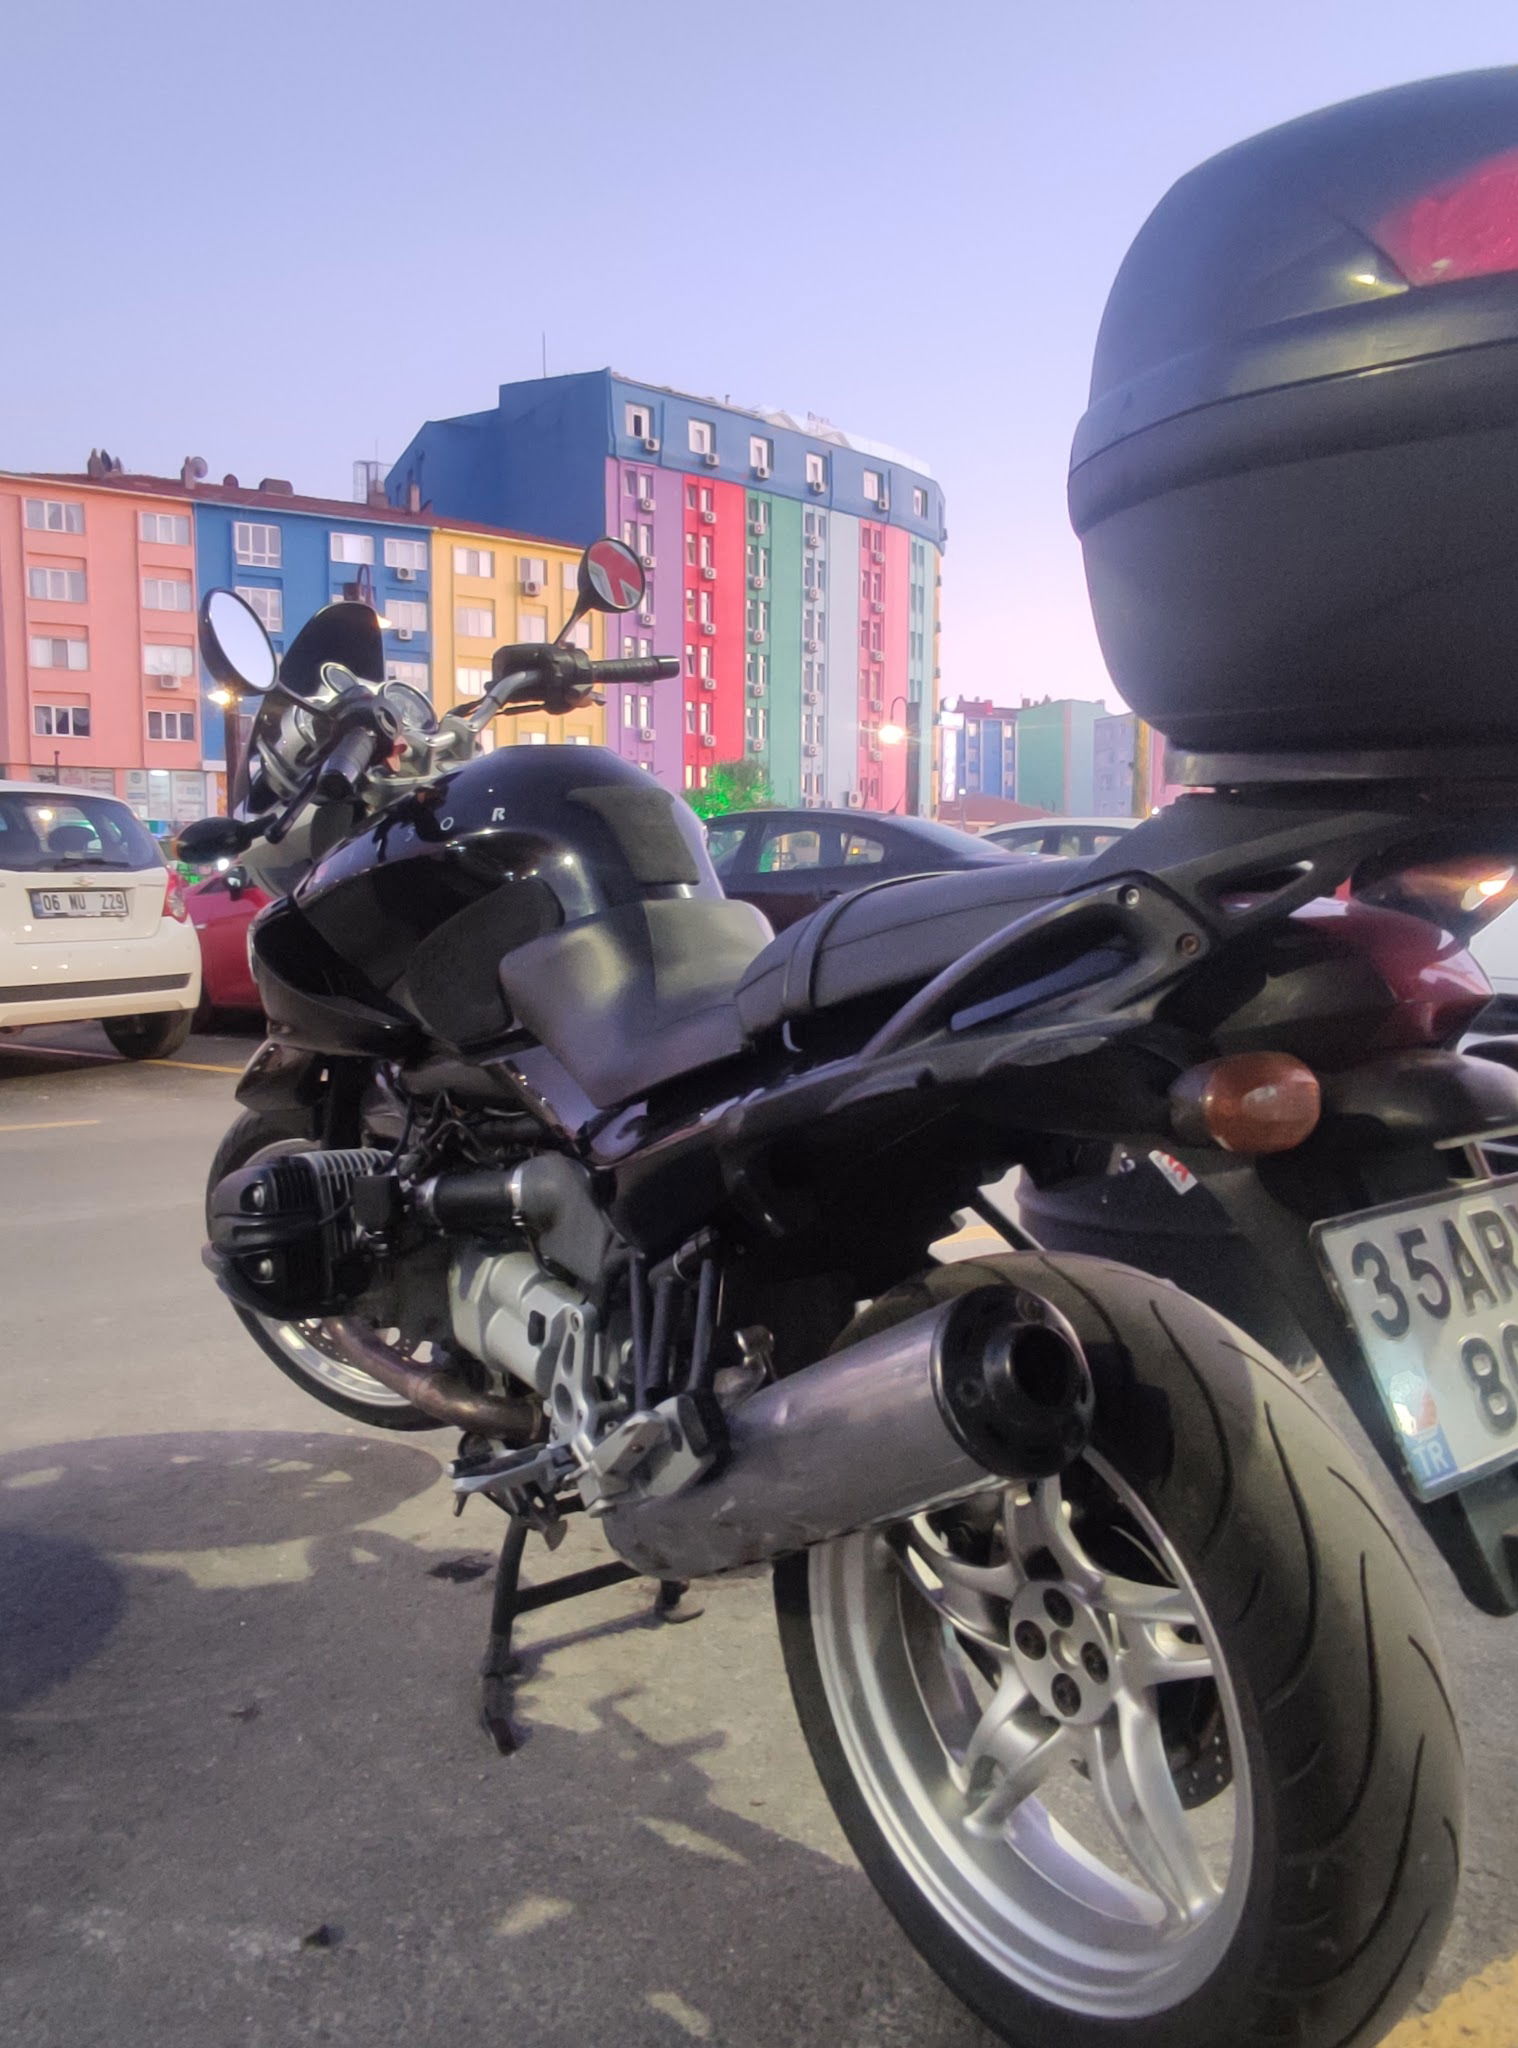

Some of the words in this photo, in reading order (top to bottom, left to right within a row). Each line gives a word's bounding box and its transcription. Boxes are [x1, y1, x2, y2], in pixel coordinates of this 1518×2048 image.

[491, 807, 506, 822] R
[42, 894, 61, 911] 06
[1351, 1203, 1518, 1340] 35AR
[1411, 1440, 1449, 1476] TR
